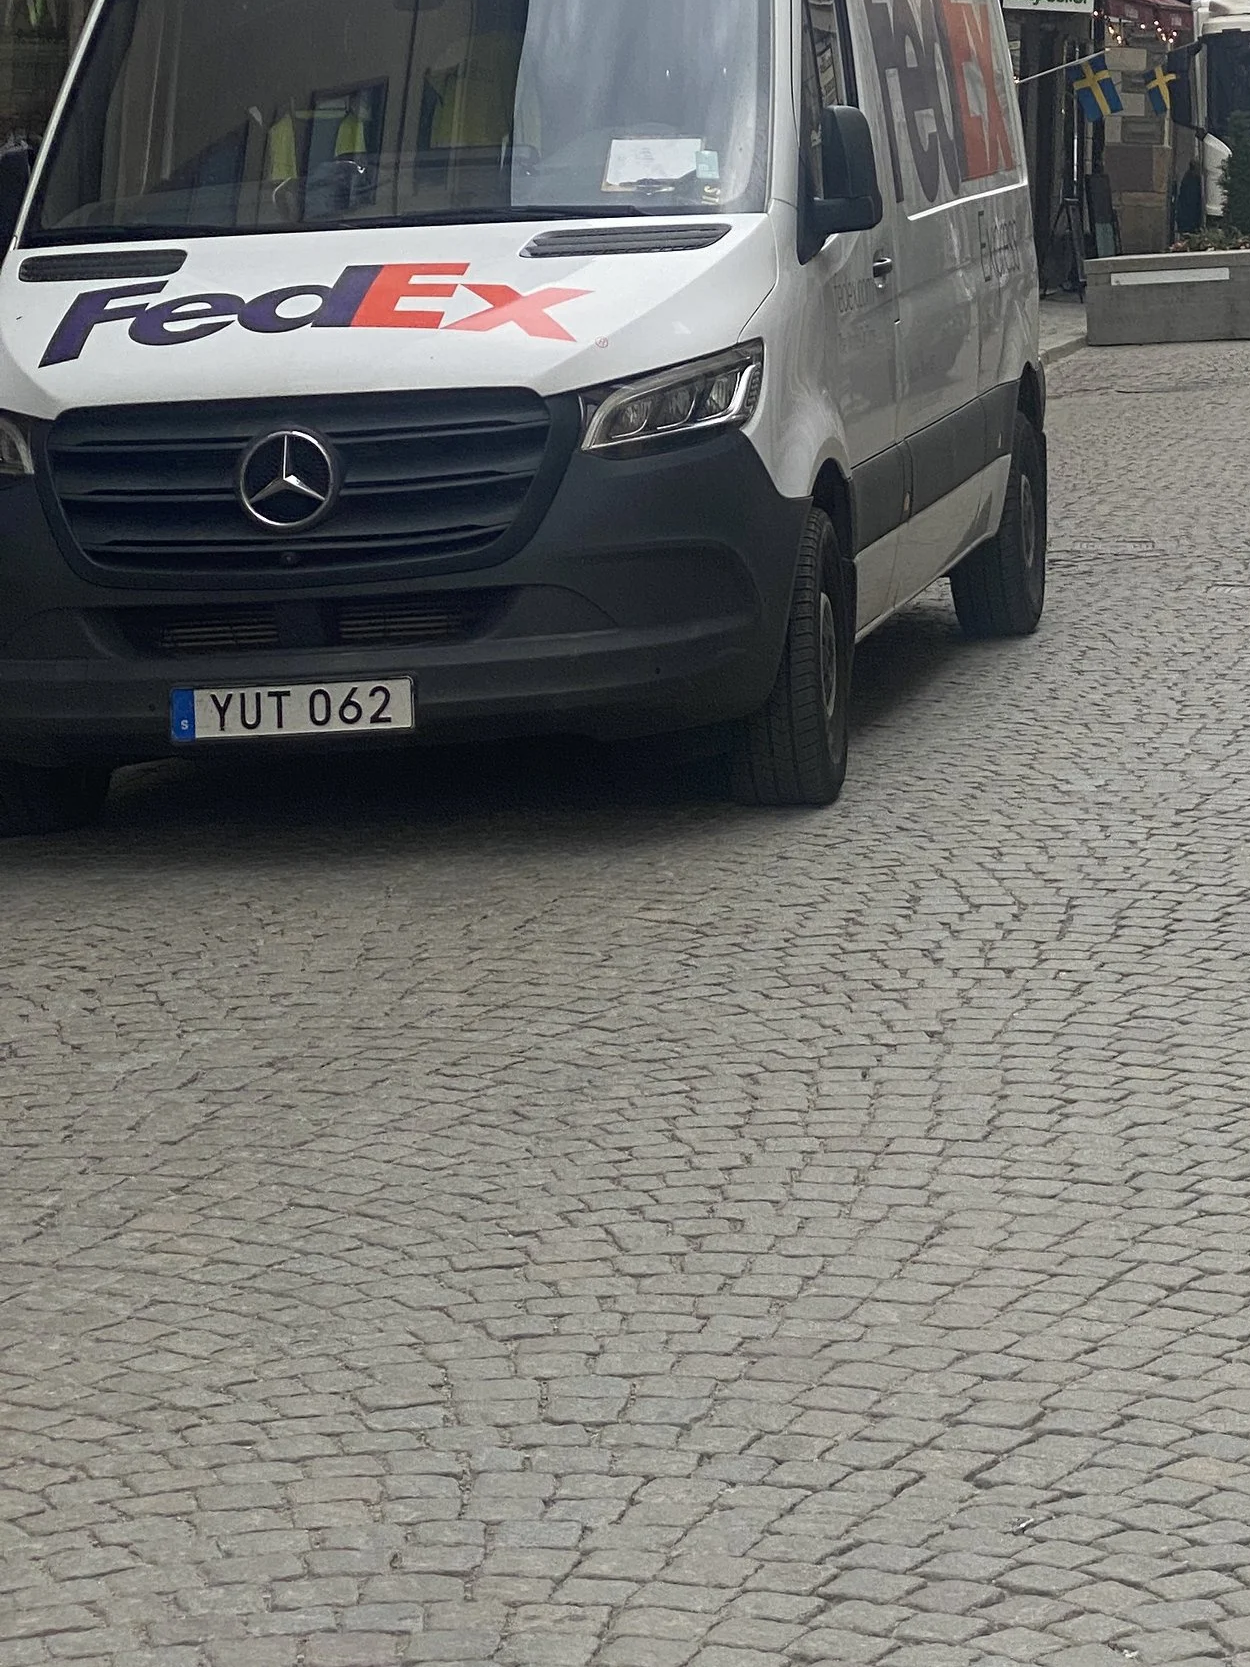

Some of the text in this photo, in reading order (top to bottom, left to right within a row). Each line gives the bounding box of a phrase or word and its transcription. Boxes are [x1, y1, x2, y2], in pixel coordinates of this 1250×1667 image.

[37, 261, 596, 369] FedEx
[210, 690, 291, 731] YUT
[309, 685, 392, 726] 062
